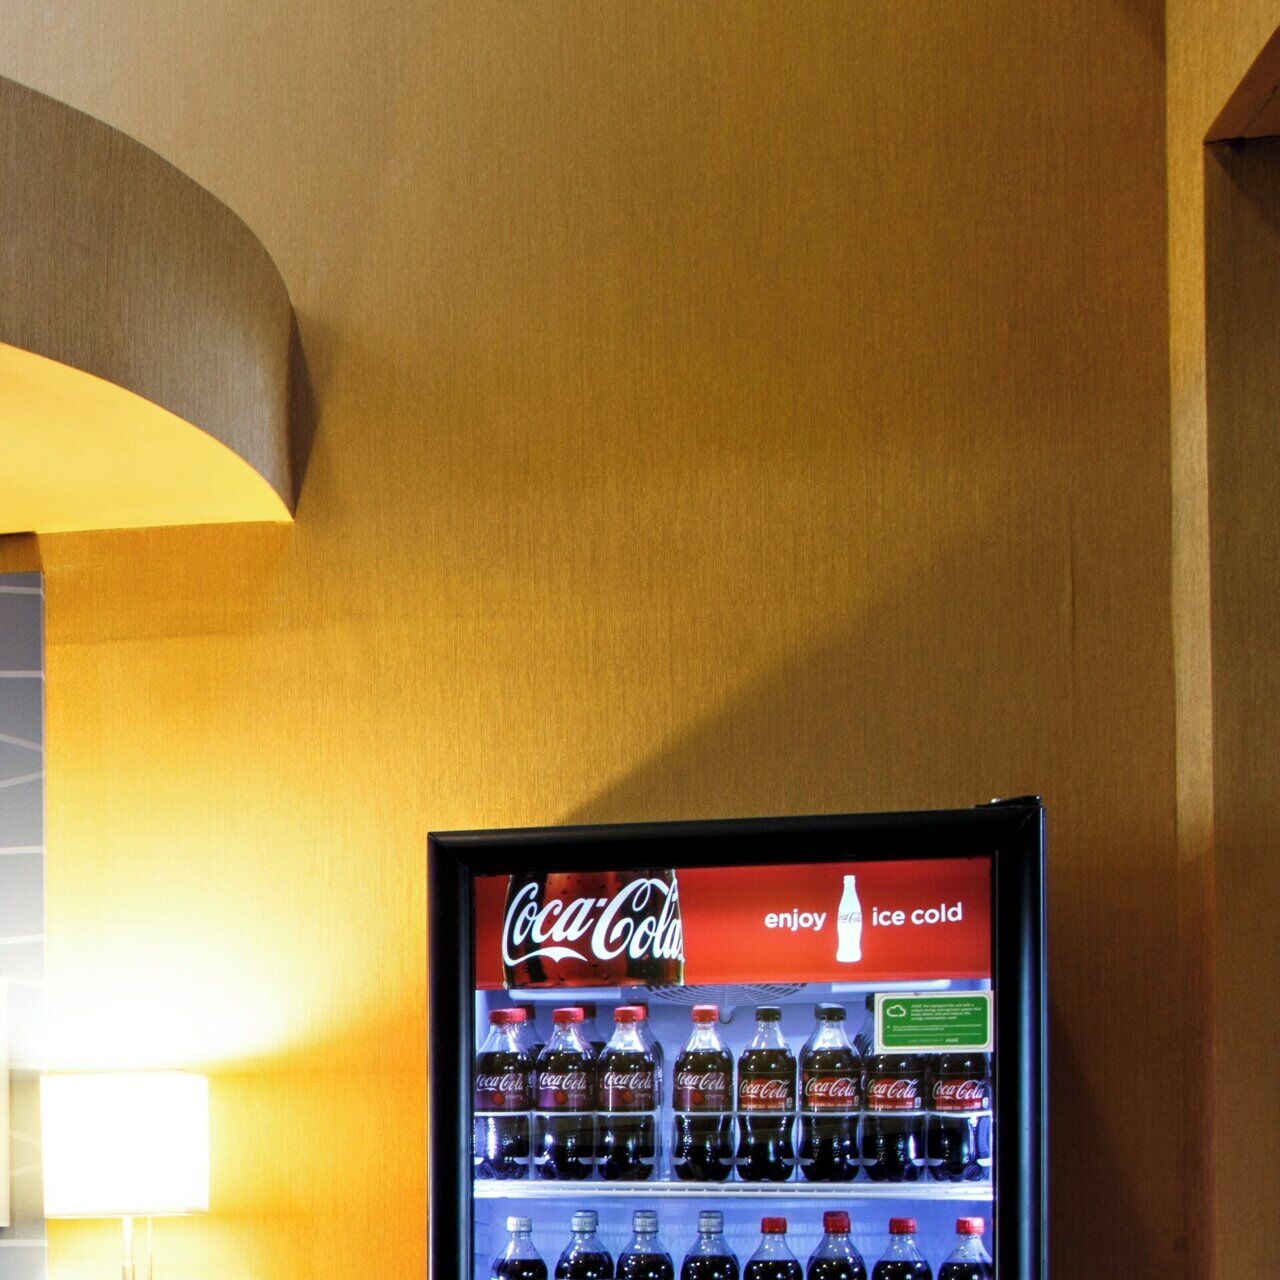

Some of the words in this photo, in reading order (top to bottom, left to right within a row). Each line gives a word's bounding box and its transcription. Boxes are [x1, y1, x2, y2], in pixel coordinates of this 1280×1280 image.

[502, 878, 684, 967] Coca-Cola
[764, 907, 827, 932] enjoy
[872, 906, 906, 926] ice
[911, 901, 963, 925] cold
[739, 1079, 789, 1098] Coca-Cola
[805, 1077, 858, 1097] Coca-Cola
[868, 1079, 919, 1099] Coca-Cola
[932, 1080, 985, 1099] Coca-Cola
